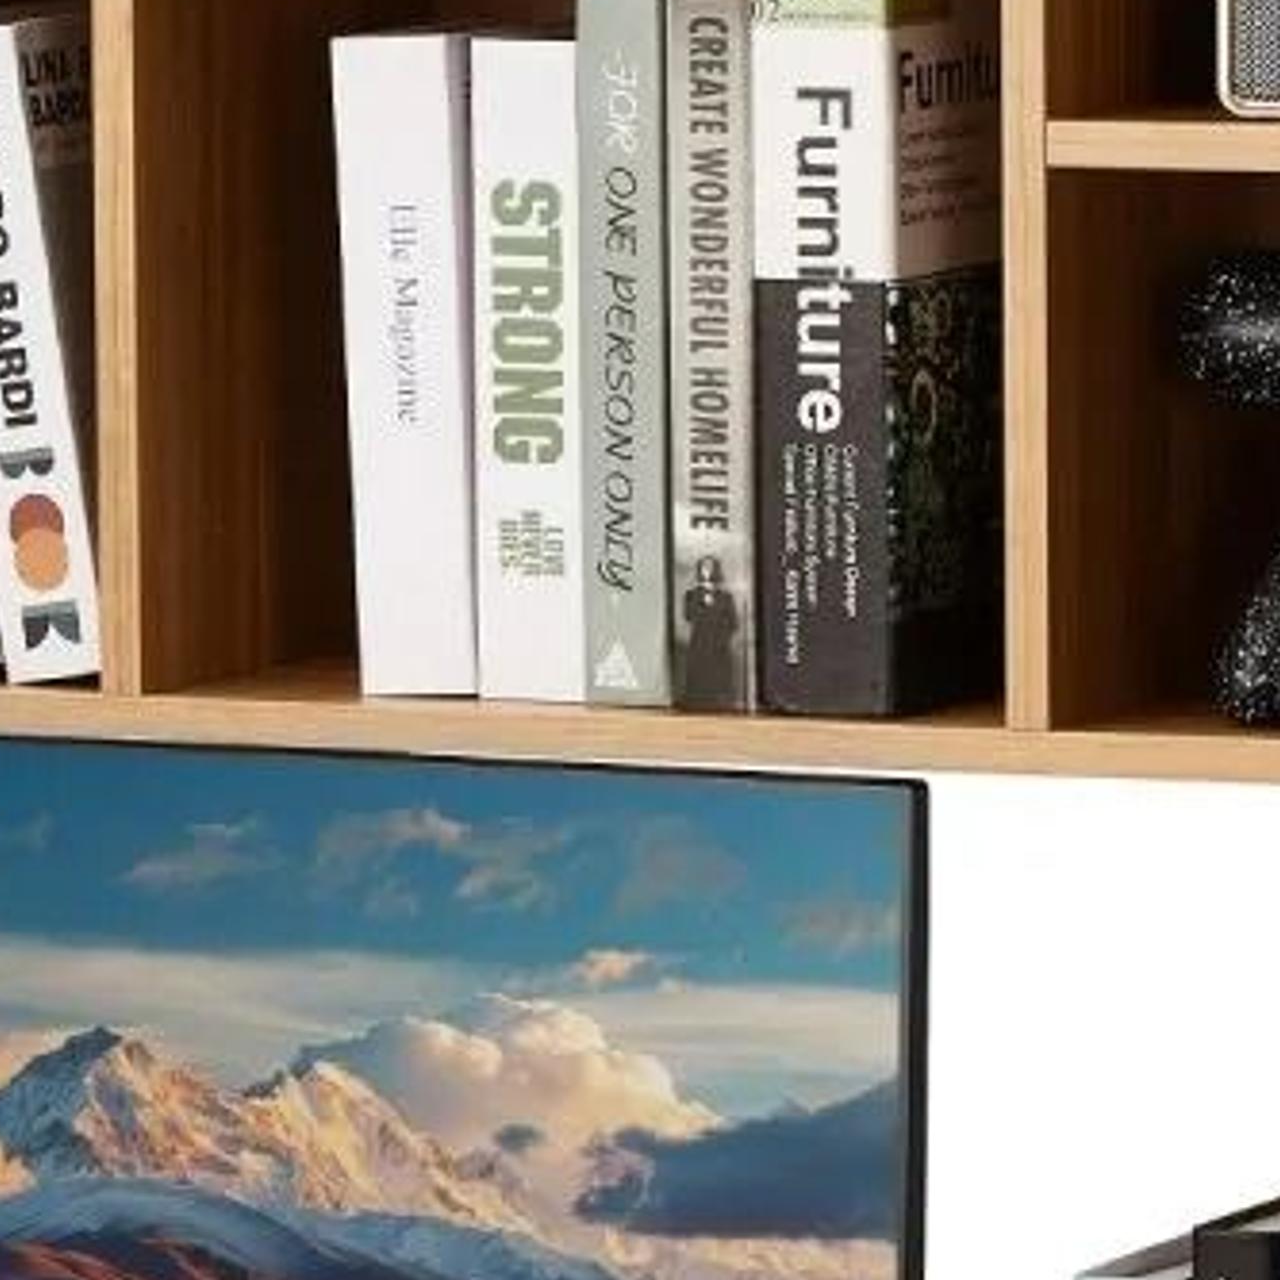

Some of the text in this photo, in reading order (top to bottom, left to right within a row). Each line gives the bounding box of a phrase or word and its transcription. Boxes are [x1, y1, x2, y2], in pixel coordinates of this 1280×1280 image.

[490, 178, 566, 466] STRONG
[604, 166, 642, 258] ONE
[688, 16, 732, 533] CREATE WONDERFUL HOMELIFE
[794, 86, 853, 433] Furniture
[600, 270, 644, 460] PERSON
[596, 469, 634, 593] ONLY
